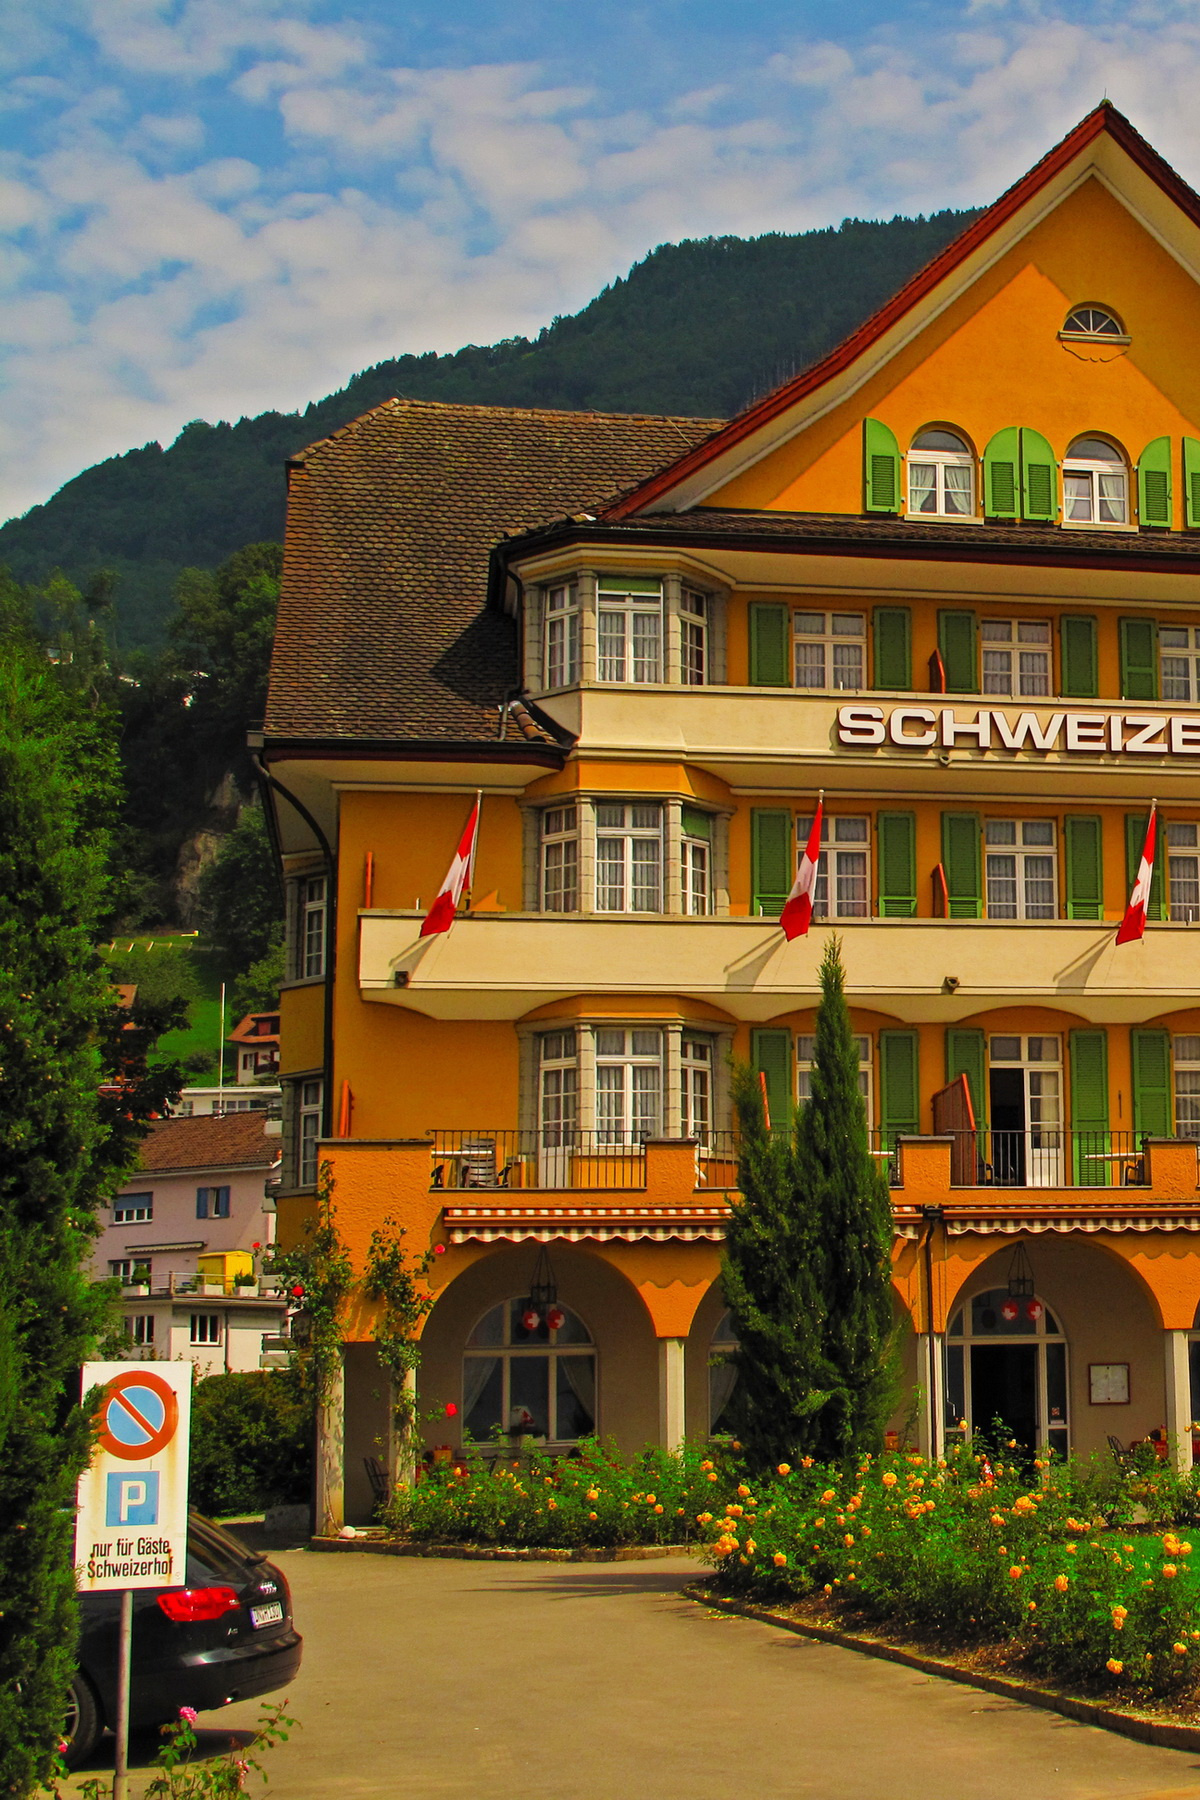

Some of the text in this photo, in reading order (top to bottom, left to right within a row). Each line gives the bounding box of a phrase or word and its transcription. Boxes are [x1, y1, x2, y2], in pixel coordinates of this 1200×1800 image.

[120, 1480, 147, 1522] P
[92, 1537, 170, 1557] nur für Gäste
[87, 1556, 174, 1578] Schweizerhof
